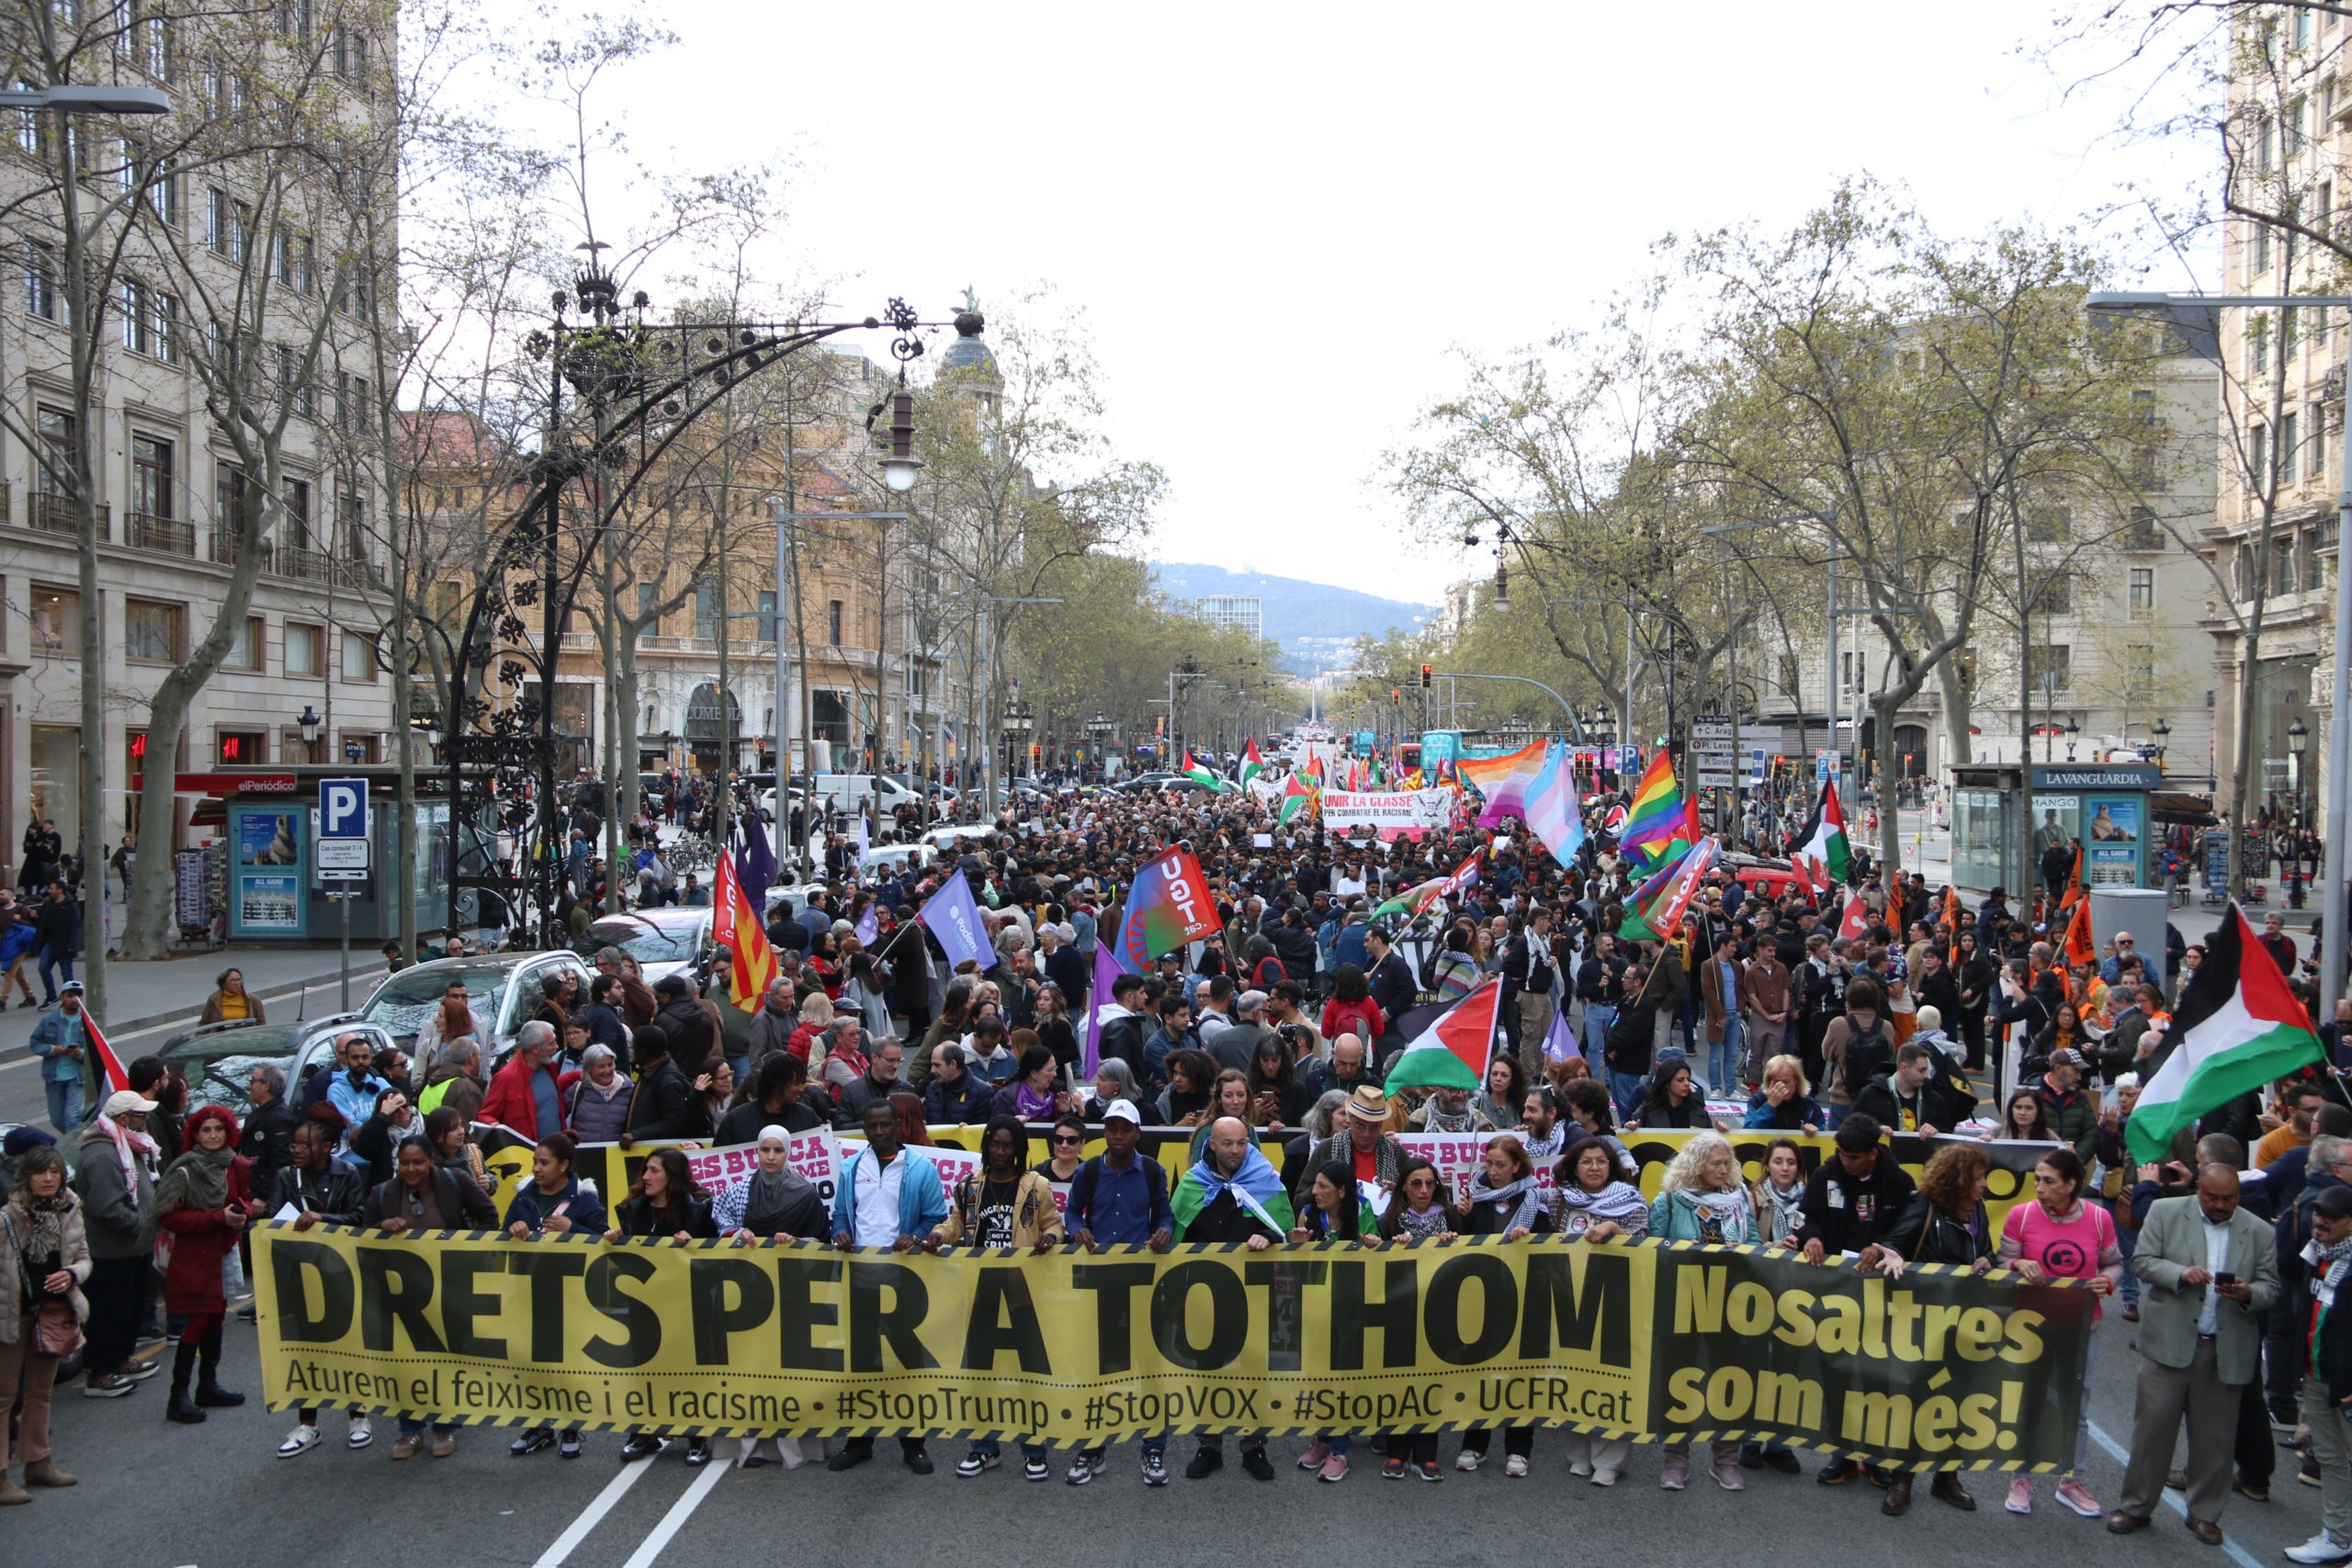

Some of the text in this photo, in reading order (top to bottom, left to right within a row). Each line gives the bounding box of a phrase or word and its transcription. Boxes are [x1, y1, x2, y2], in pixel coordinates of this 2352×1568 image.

[1702, 741, 1712, 750] Pl.
[1714, 728, 1732, 736] Arag
[1625, 747, 1636, 762] P
[329, 786, 357, 831] P
[1323, 808, 1412, 818] PER COMBATRE EL RACISME
[1324, 795, 1350, 807] UNIR
[1352, 796, 1367, 807] LA
[724, 1135, 829, 1175] BUCA
[271, 1238, 1632, 1376] DRETS PER A TOTHOM
[1672, 1264, 2047, 1364] Nosaltres
[285, 1359, 1633, 1436] Aturem el feixisme i el racisme #StopTrump #StopVOX #StopAC UCFR.cat
[1664, 1365, 2025, 1452] som més!
